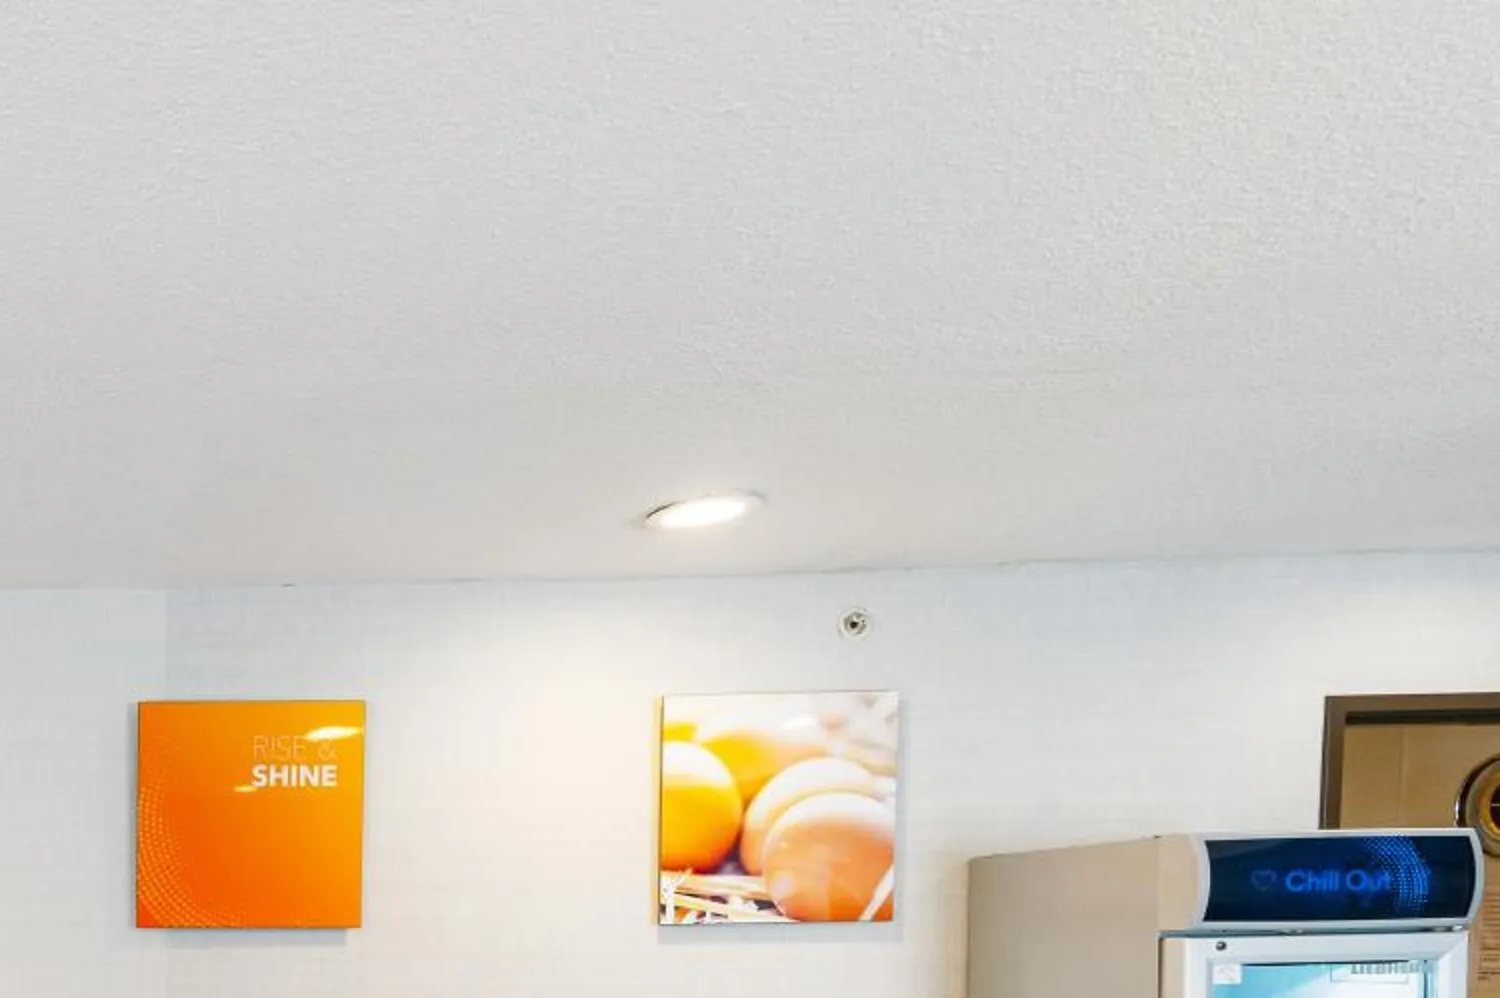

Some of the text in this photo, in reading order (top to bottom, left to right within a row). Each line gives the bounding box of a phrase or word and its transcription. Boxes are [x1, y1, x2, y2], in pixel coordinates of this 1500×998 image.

[253, 734, 337, 761] RISE &
[252, 763, 338, 787] SHINE
[1285, 868, 1391, 891] Chill Out
